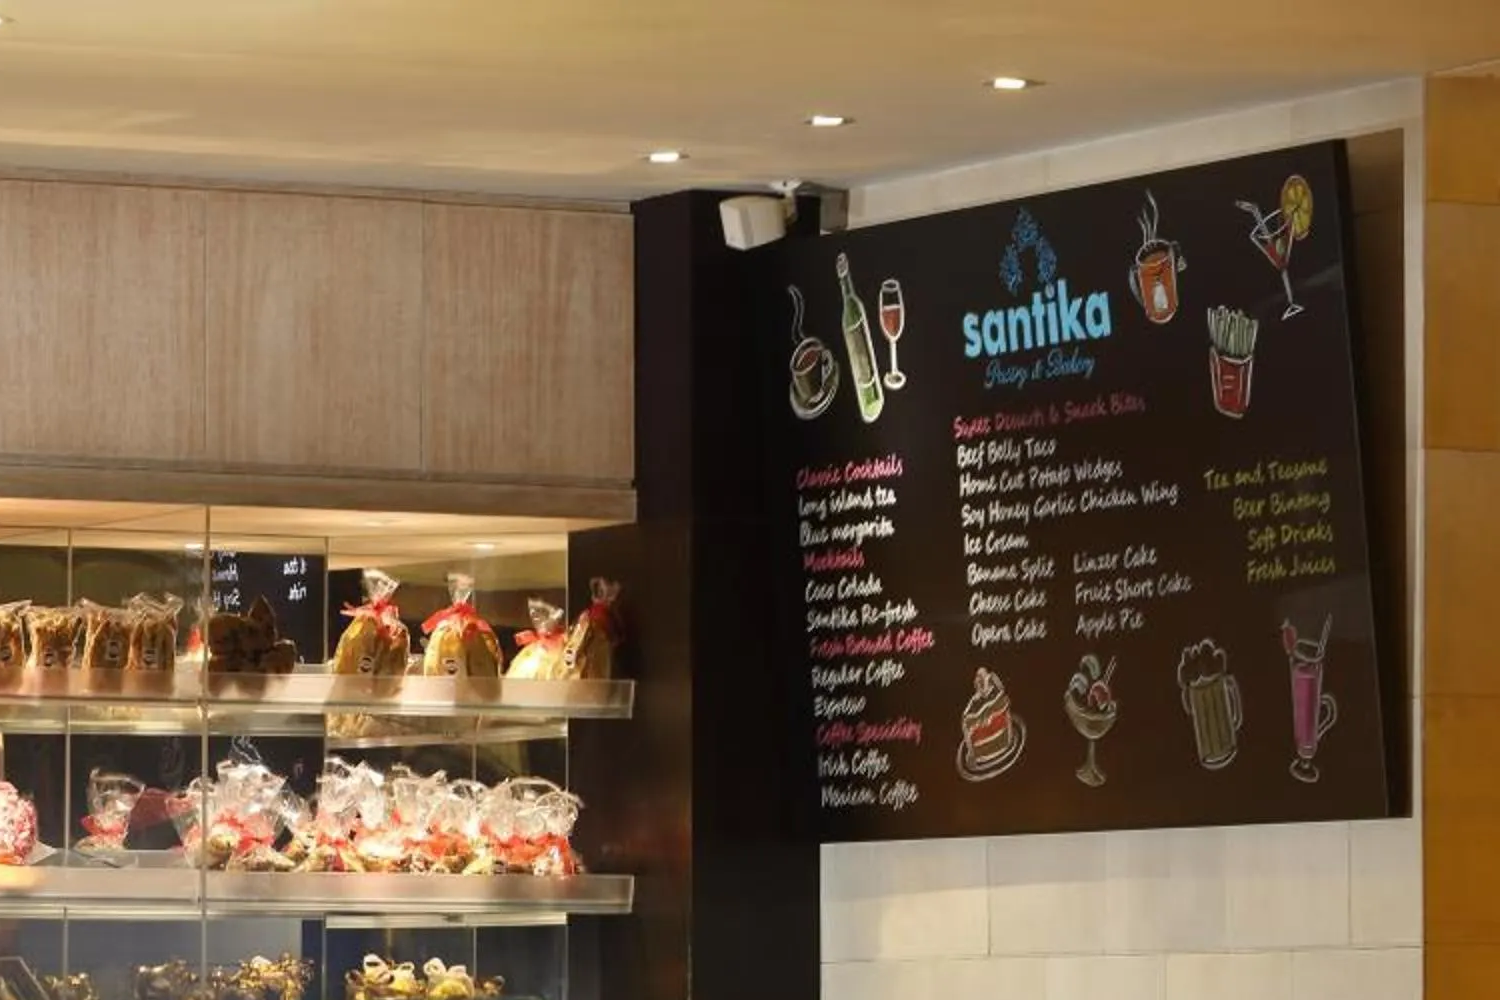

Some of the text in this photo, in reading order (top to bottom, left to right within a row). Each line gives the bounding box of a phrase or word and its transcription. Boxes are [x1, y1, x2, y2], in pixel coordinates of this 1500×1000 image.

[963, 277, 1112, 358] santika
[1045, 348, 1096, 379] Bakery
[953, 415, 991, 439] Sweet
[1064, 395, 1107, 424] Snack
[1110, 390, 1146, 415] Bites
[957, 437, 1058, 470] Beef Belly Taco
[797, 452, 904, 490] Classic Cocktails
[959, 456, 1123, 497] Home Cut Potato Wedges
[1203, 469, 1231, 490] Tea
[799, 484, 897, 520] Long island tea
[961, 480, 1179, 529] Soy Honey Garlic Chicken Wing
[1233, 491, 1331, 520] Beer Bintang
[800, 515, 895, 546] Blue margarita
[963, 530, 1029, 557] Ice Cream
[1248, 519, 1333, 555] Soft Drinks
[804, 547, 865, 572] Mocktails
[967, 555, 1056, 586] Banana Split
[1073, 543, 1157, 574] Linzer Cake
[1247, 553, 1336, 584] Fresh Juices
[837, 572, 883, 600] Colada
[1075, 571, 1193, 605] Fruit Short Cake
[969, 588, 1048, 616] Cheese Cake
[807, 604, 859, 632] Santika
[971, 617, 1048, 649] Opera Cake
[1076, 607, 1145, 639] Apple Pie
[896, 627, 936, 654] Coffee
[811, 658, 905, 693] Regular Coffee
[818, 749, 890, 780] Irish Coffee
[821, 779, 919, 811] Mexican Coffee
